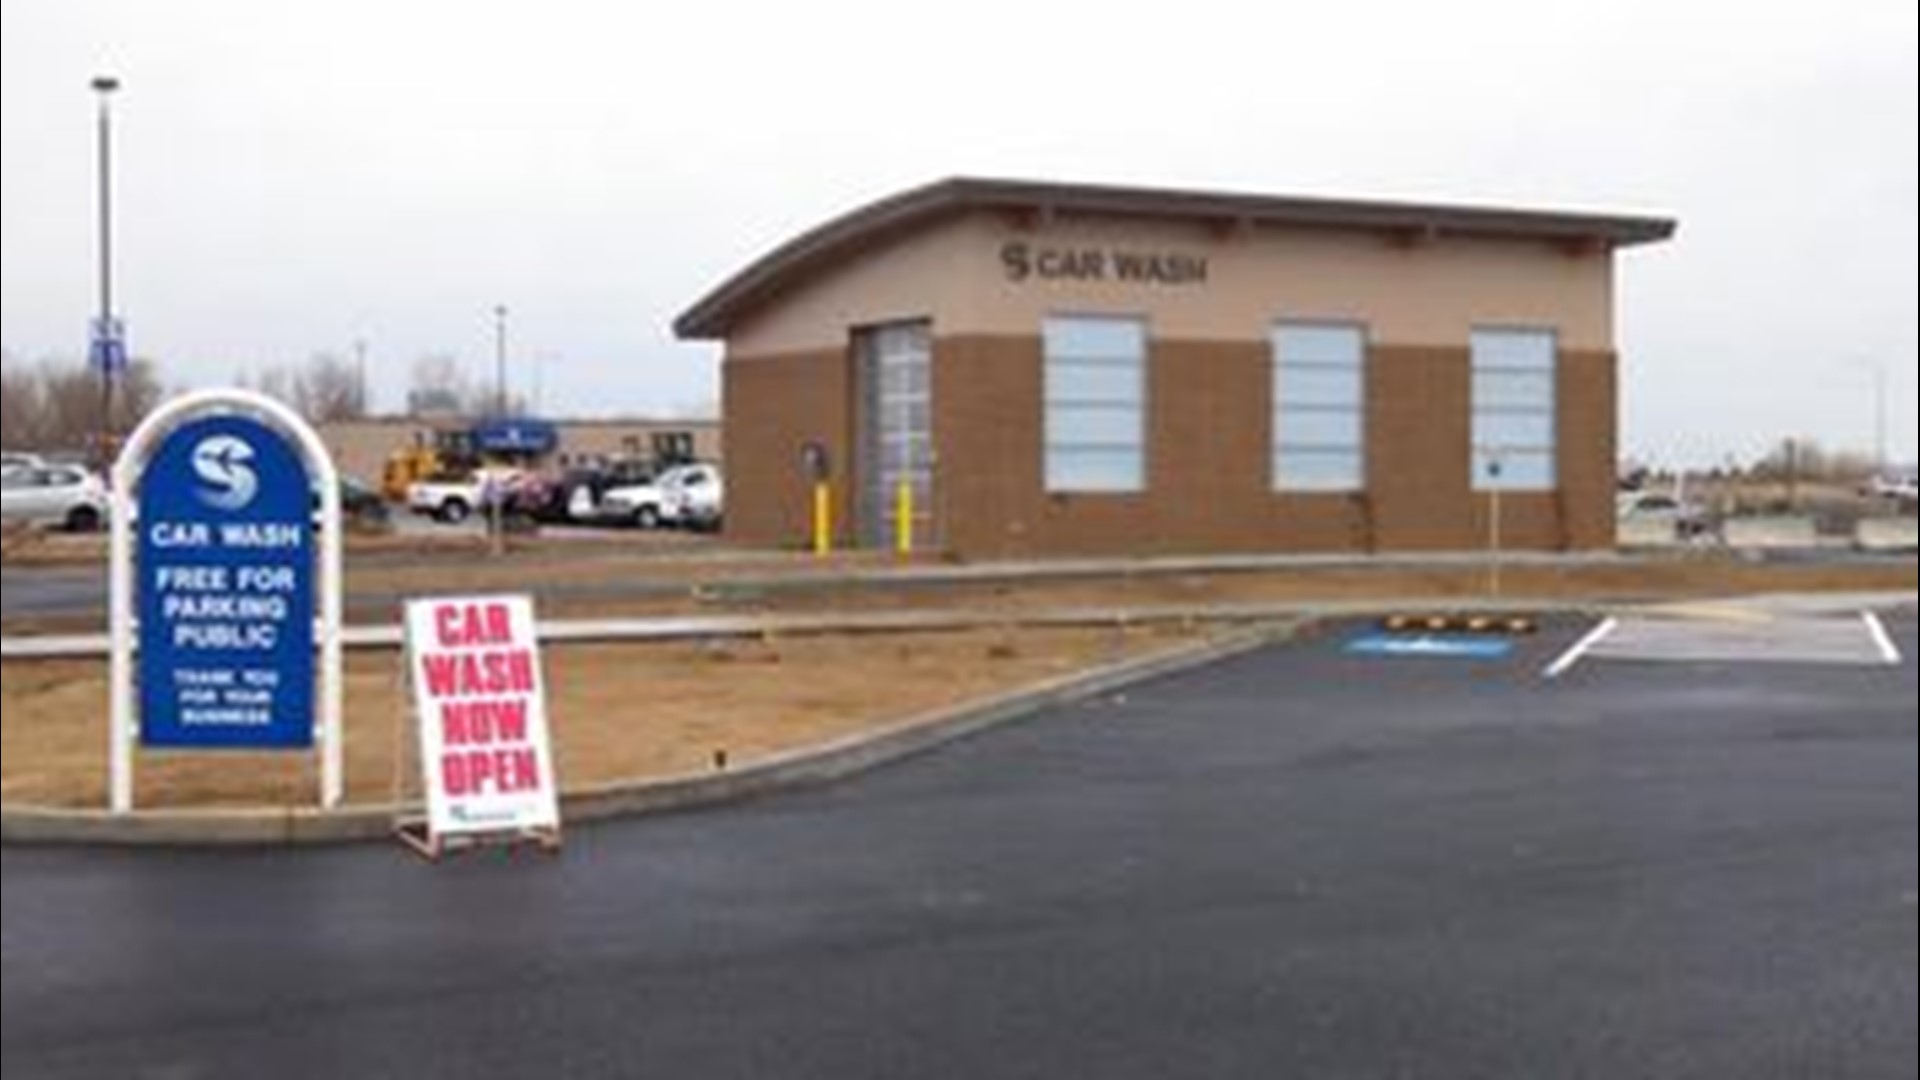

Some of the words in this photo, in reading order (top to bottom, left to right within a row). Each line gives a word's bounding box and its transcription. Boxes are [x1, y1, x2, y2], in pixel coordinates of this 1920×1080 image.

[1037, 251, 1104, 280] CAR
[1113, 254, 1207, 284] WASH
[151, 523, 208, 547] CAR
[220, 523, 301, 547] WASH
[156, 567, 228, 590] FREE
[237, 567, 294, 590] FOR
[163, 595, 287, 619] PARKING
[174, 624, 276, 649] PUBLIC
[435, 604, 511, 646] CAR
[422, 650, 534, 697] WASH
[442, 699, 525, 745] NOW
[442, 749, 539, 796] OPEN
